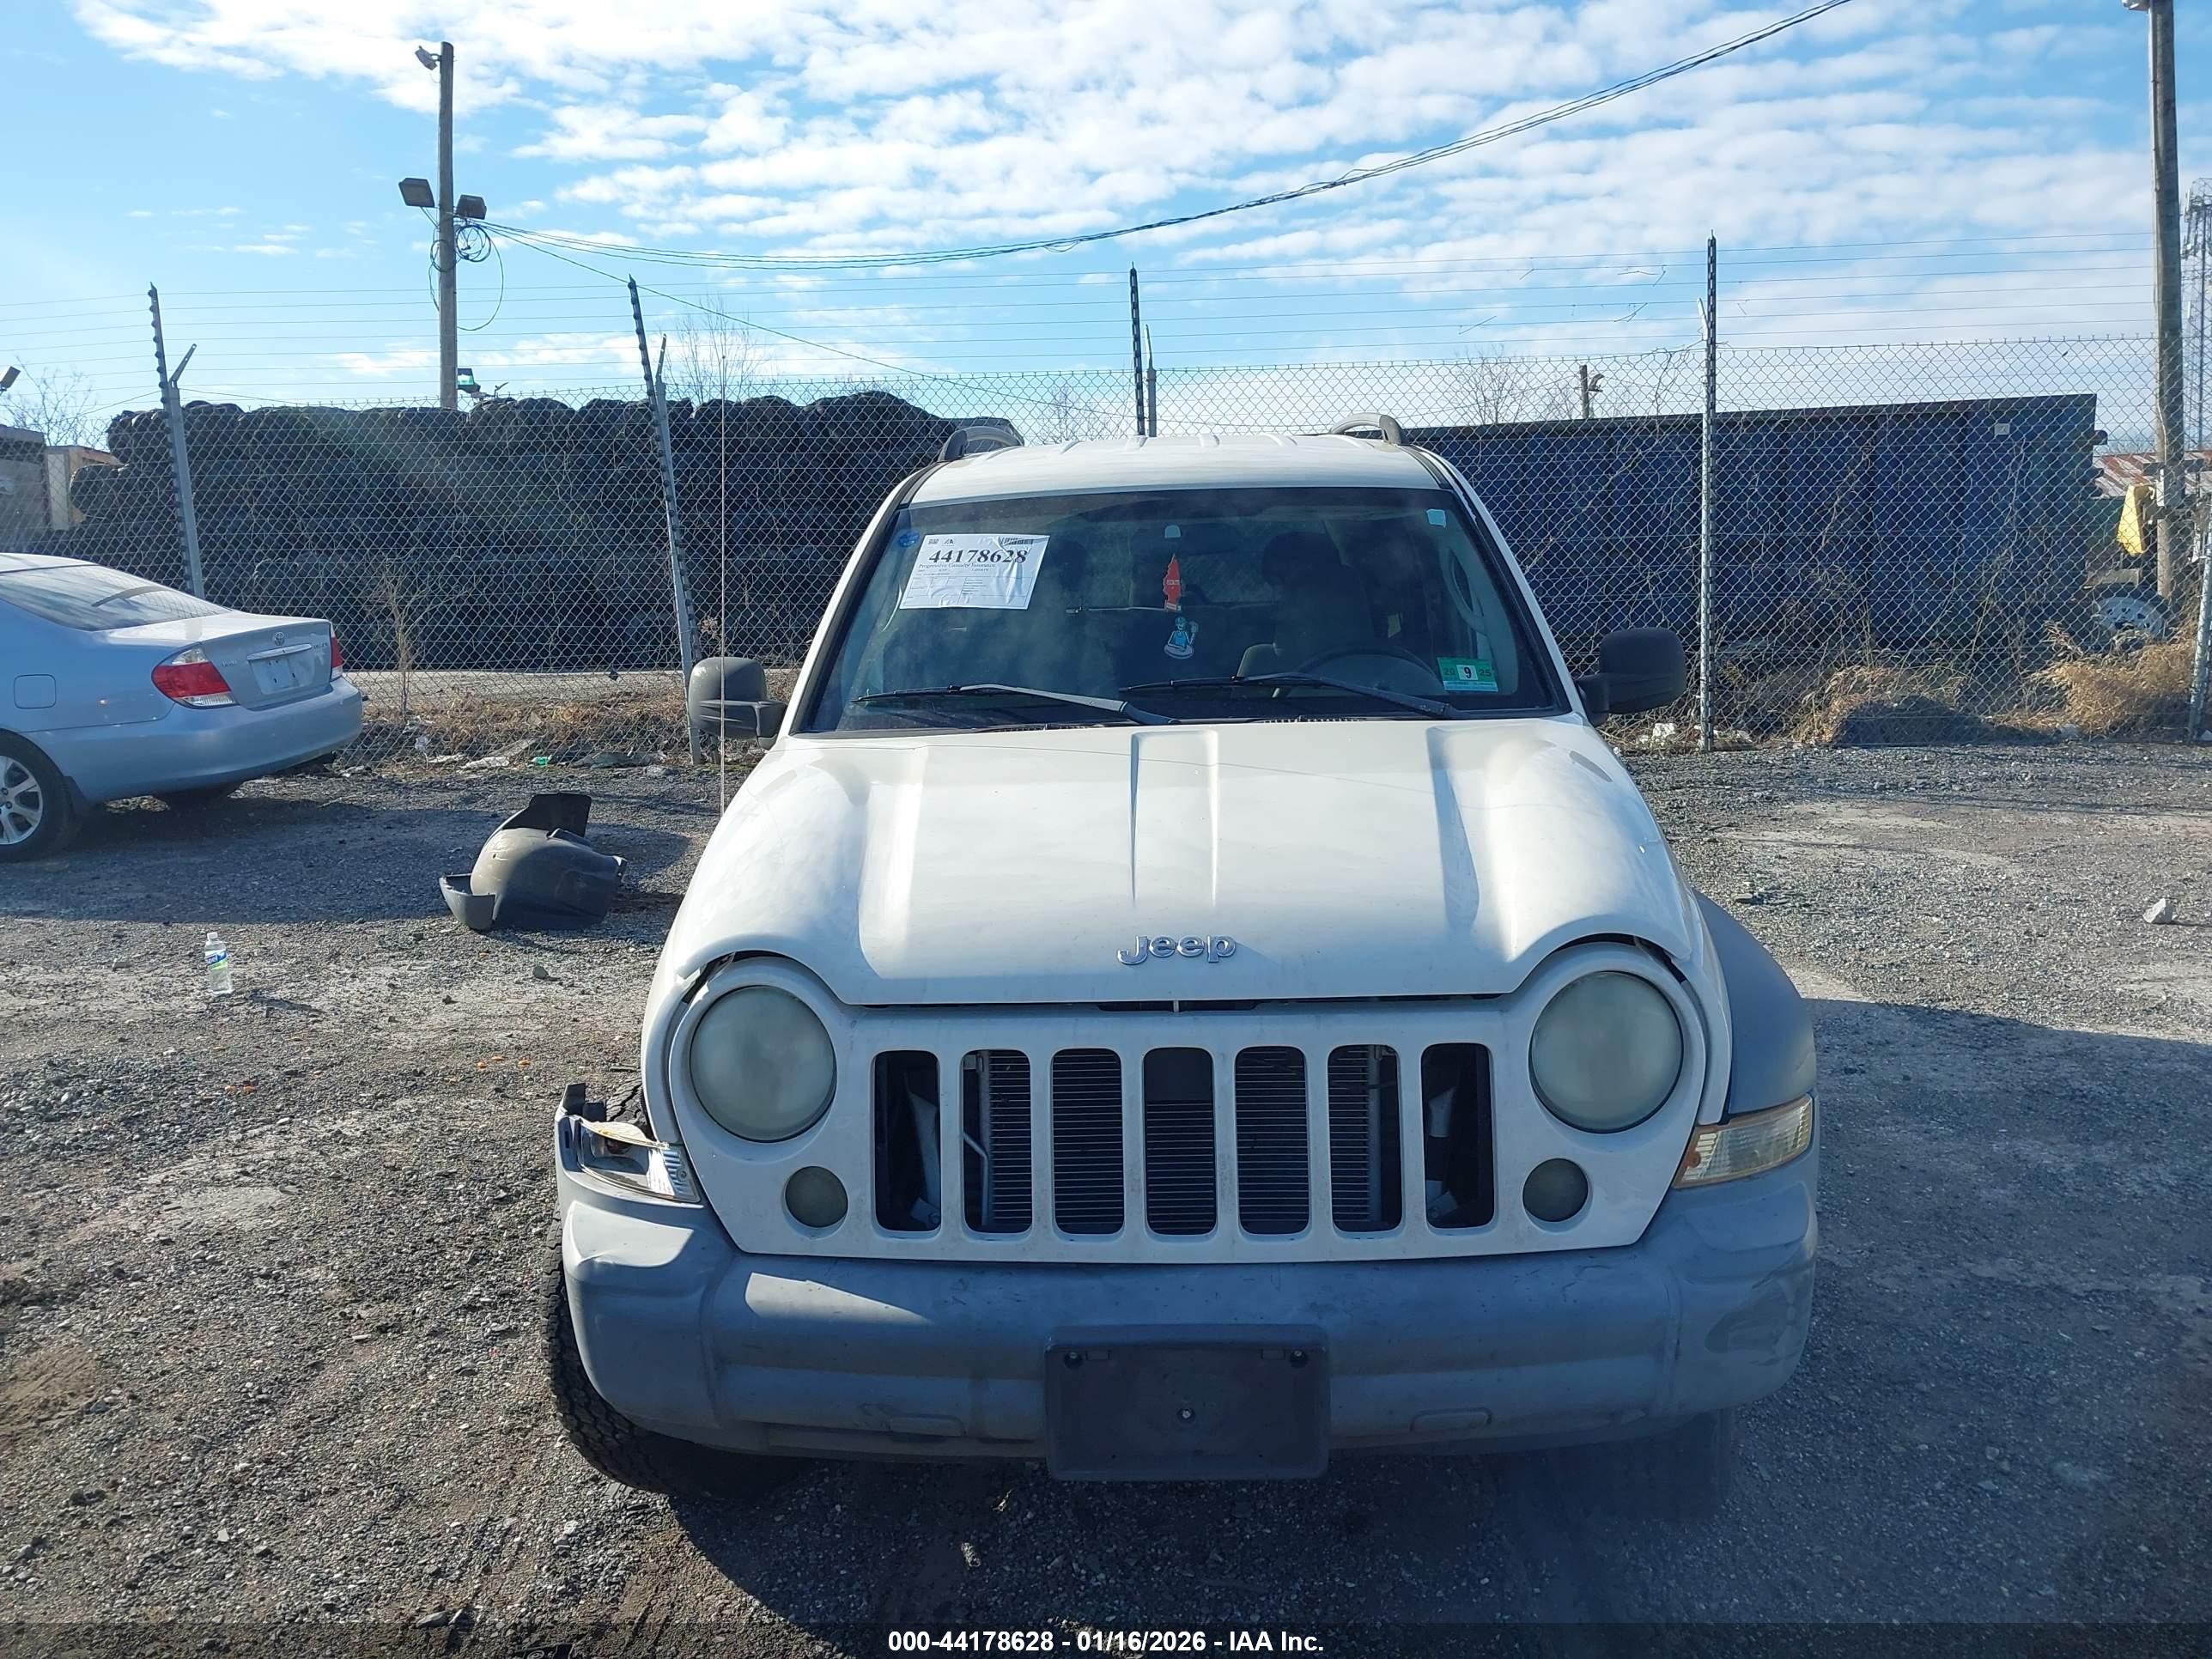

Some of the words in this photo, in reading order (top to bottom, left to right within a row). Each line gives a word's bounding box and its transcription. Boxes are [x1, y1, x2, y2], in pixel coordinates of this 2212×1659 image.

[929, 549, 1028, 563] 44178628
[1463, 666, 1472, 679] 9
[1116, 934, 1237, 965] Jeep
